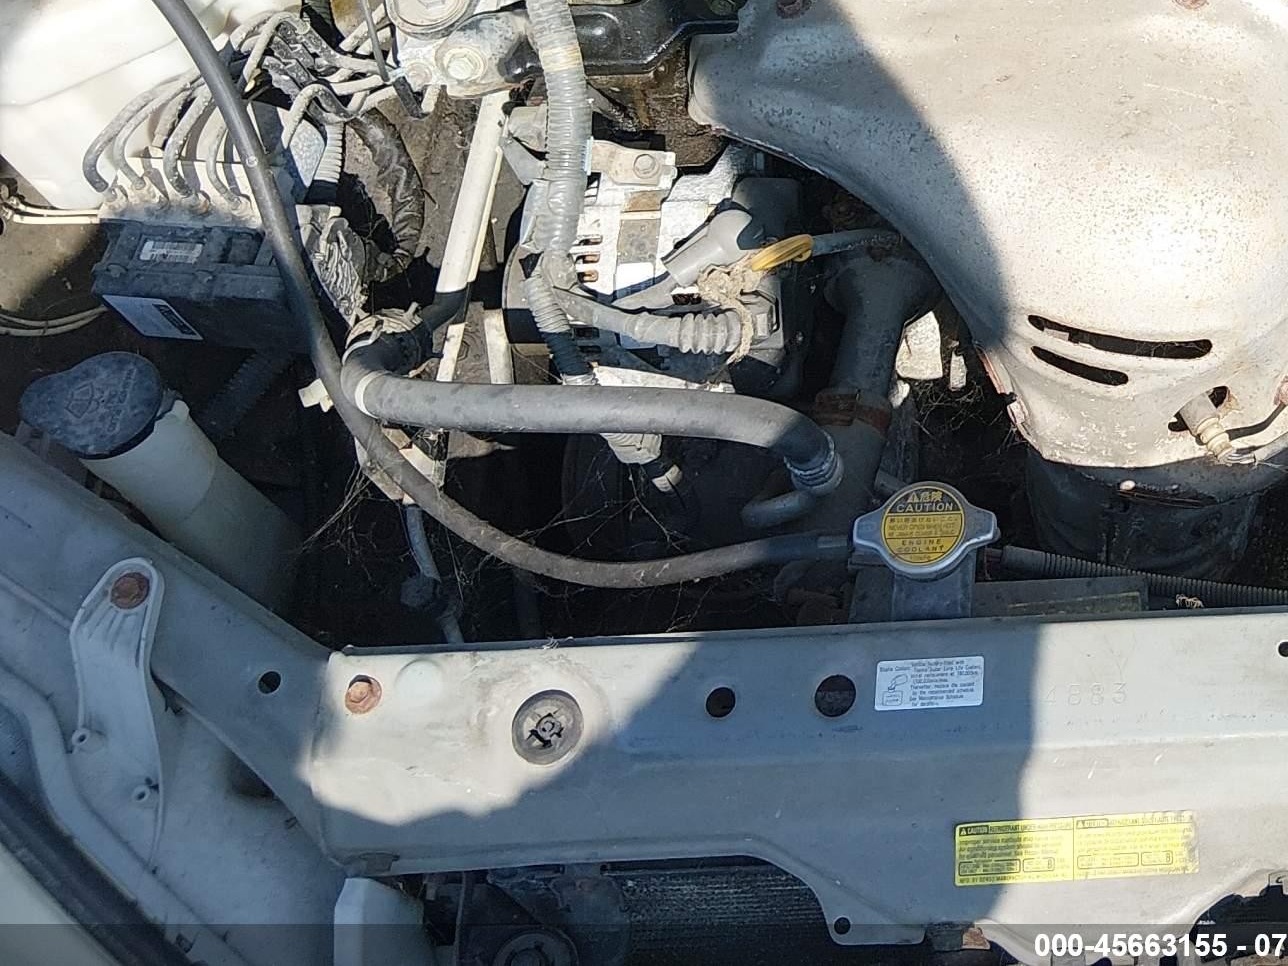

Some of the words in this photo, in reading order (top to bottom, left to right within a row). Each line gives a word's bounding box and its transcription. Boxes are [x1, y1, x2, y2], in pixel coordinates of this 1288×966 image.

[896, 502, 954, 513] CAUTION
[901, 538, 942, 546] ENGINE
[896, 545, 945, 553] COOLANT
